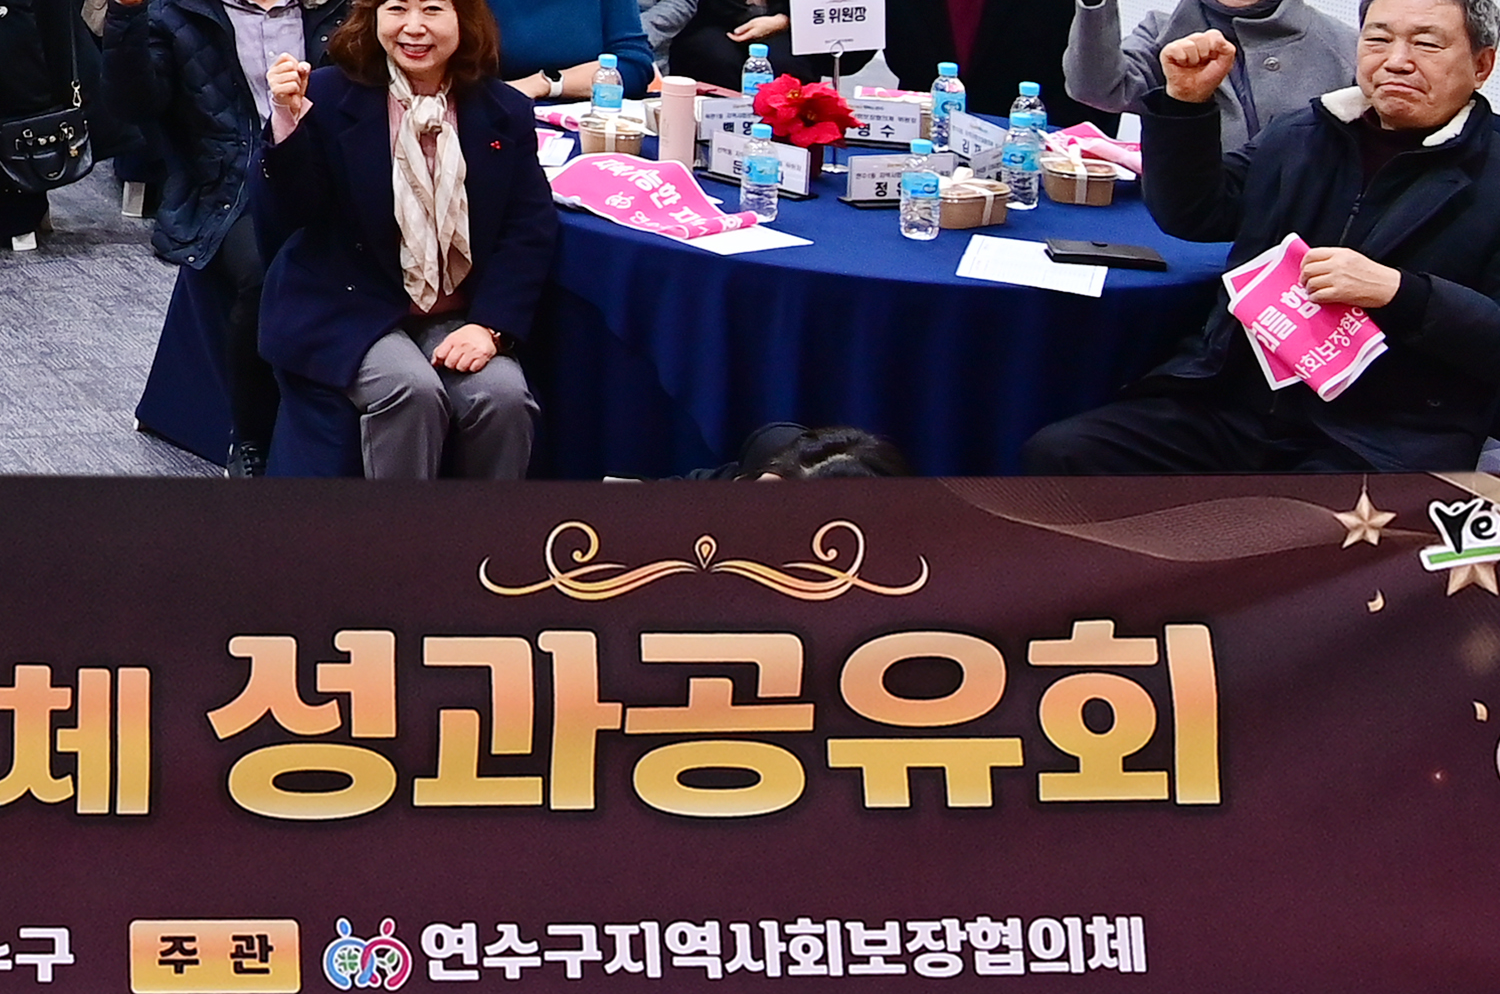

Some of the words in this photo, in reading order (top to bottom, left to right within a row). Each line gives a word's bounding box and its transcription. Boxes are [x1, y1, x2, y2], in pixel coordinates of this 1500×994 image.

[812, 8, 826, 25] 동
[828, 6, 868, 24] 위원장
[207, 619, 1221, 820] 성과공유회
[420, 916, 1147, 982] 연수구지역사회보장협의체
